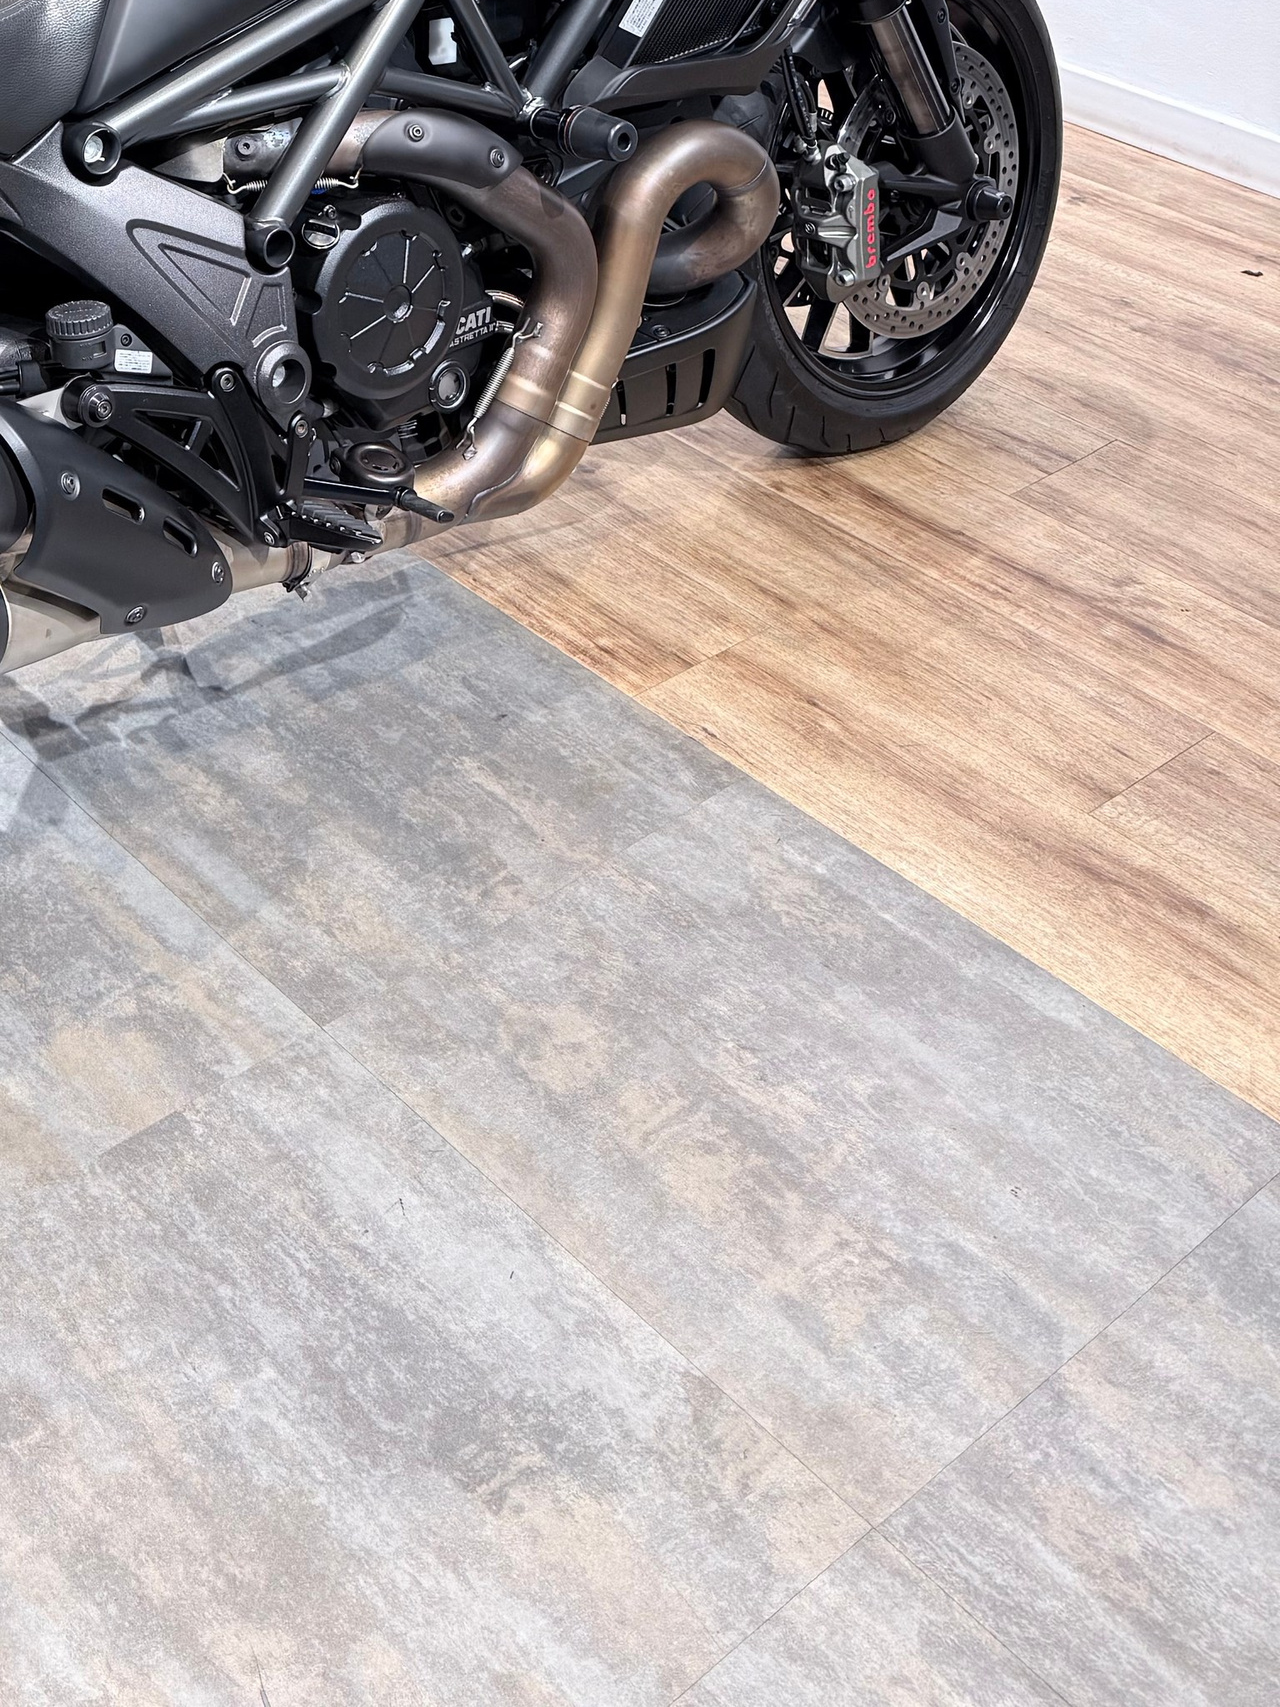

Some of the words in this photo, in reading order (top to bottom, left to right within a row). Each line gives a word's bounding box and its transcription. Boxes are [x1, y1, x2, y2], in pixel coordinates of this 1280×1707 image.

[863, 188, 877, 269] brembo
[455, 306, 492, 335] CATI
[449, 328, 489, 348] ASTRETTA
